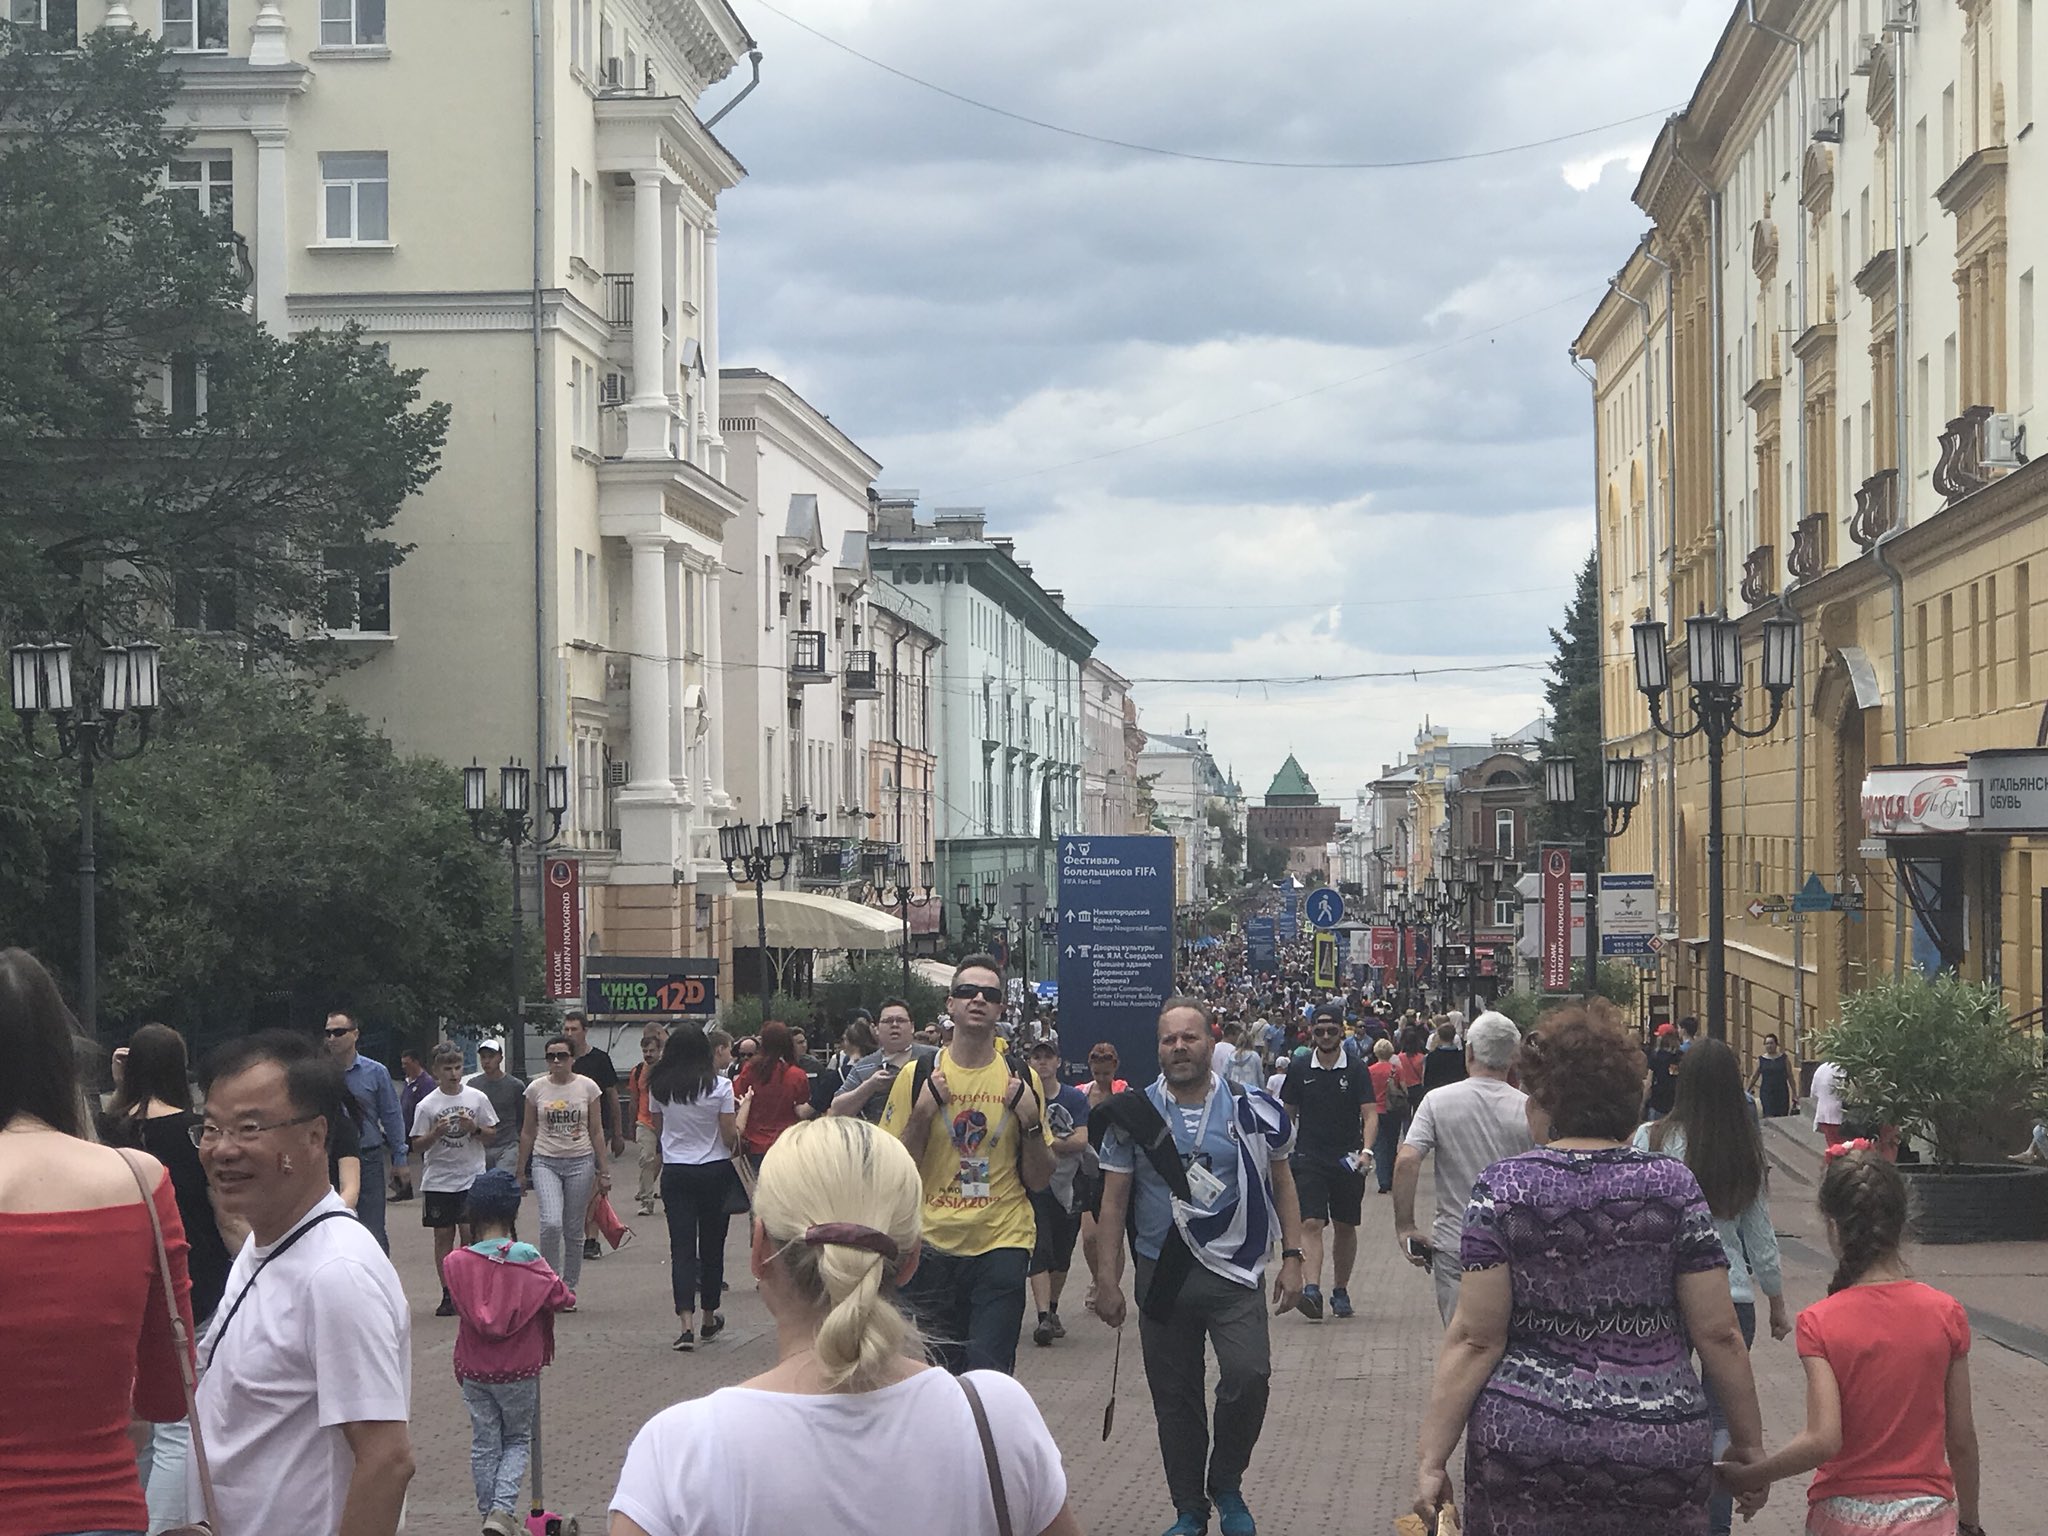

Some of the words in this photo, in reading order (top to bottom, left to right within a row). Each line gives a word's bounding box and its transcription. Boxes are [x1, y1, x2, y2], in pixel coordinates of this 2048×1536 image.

[1991, 795, 2021, 809] ОБУВЬ
[1063, 855, 1120, 865] Фестиваль
[1063, 866, 1133, 877] болельщиков
[1135, 867, 1157, 876] FIFA
[562, 892, 571, 945] NOVGOROD
[1092, 908, 1150, 917] Нижегородский
[1092, 917, 1121, 925] Кремль
[1092, 944, 1121, 952] Дворец
[1124, 952, 1163, 960] Свердлова
[1092, 969, 1140, 977] Дворянского
[1557, 973, 1564, 986] TO
[564, 983, 571, 995] TO
[601, 983, 648, 996] КИНО
[656, 980, 705, 1010] 12D
[609, 997, 658, 1010] ТЕАТР
[547, 1109, 580, 1124] MERCI
